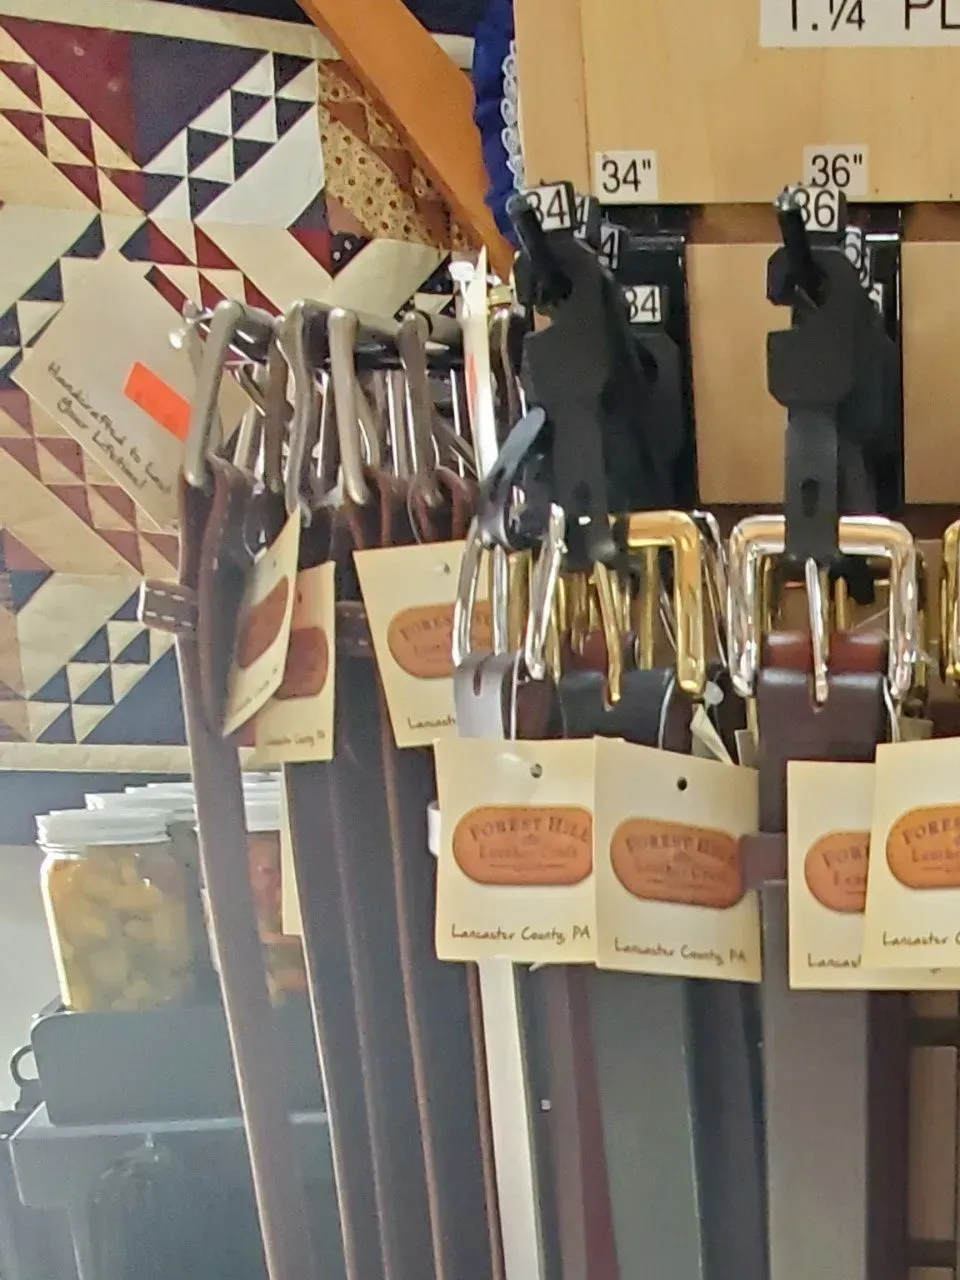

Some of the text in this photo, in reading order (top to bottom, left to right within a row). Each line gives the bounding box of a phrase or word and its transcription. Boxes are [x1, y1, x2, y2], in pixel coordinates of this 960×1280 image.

[602, 158, 652, 193] 34"
[811, 154, 862, 187] 36"
[469, 815, 589, 843] FOREST HILL
[451, 923, 515, 940] Lancaster
[572, 925, 591, 940] PA
[882, 930, 948, 946] Lancaster
